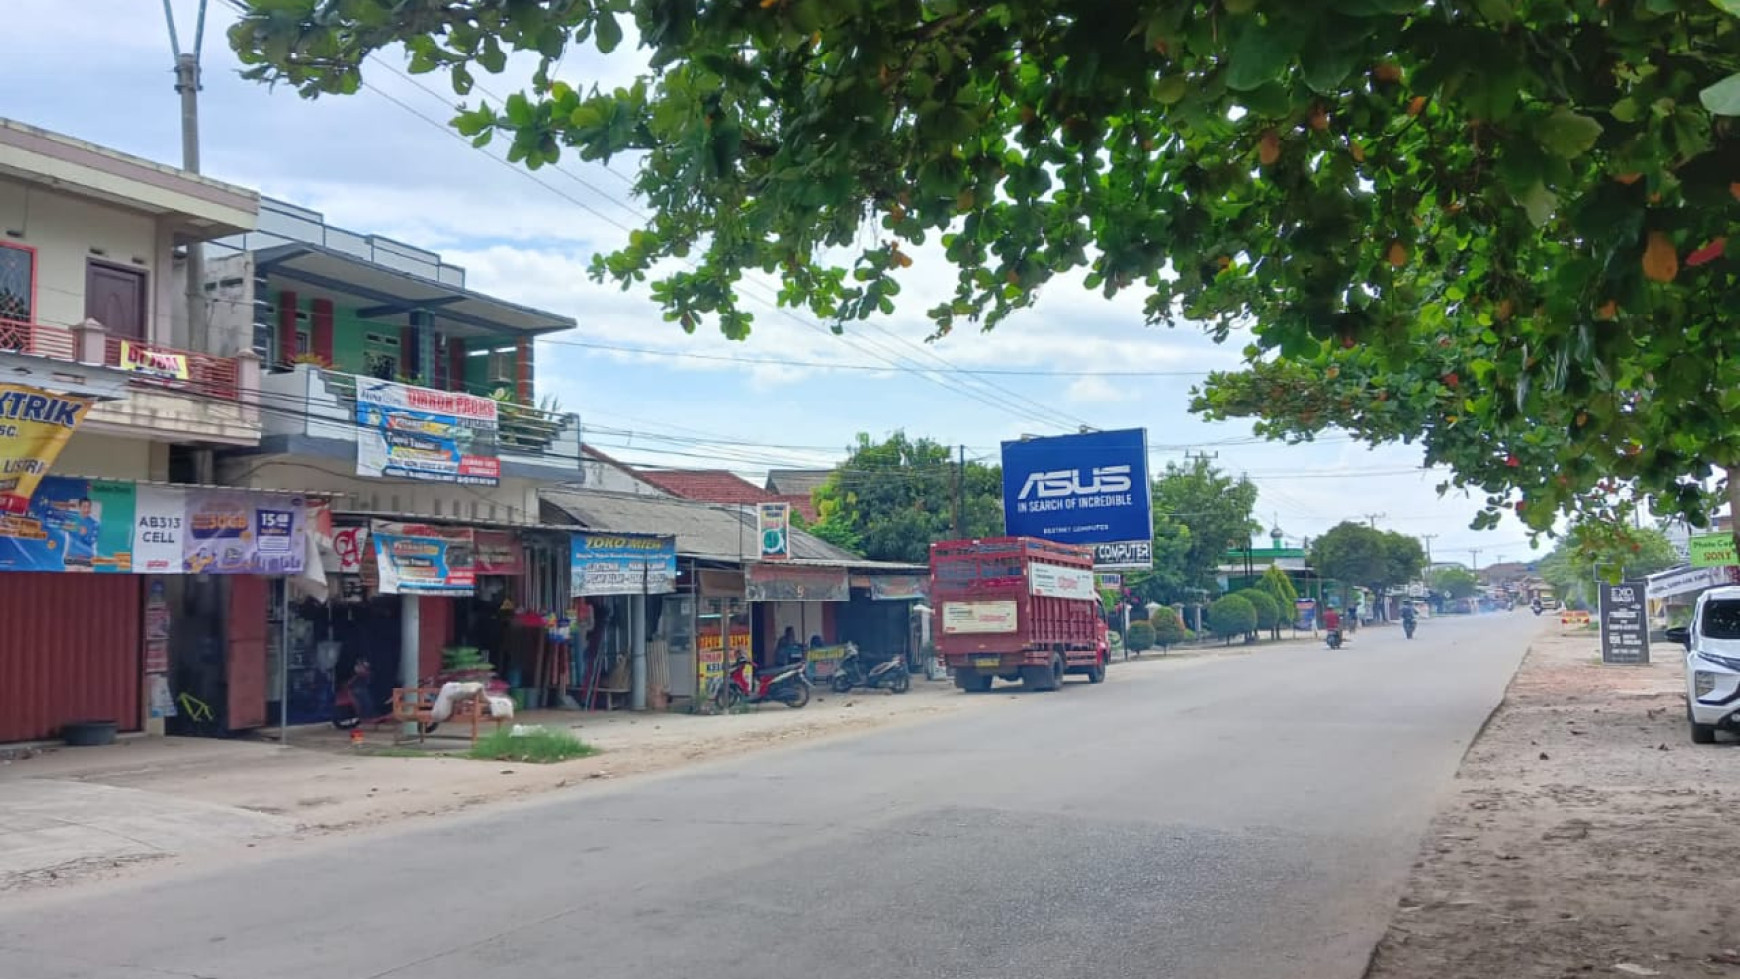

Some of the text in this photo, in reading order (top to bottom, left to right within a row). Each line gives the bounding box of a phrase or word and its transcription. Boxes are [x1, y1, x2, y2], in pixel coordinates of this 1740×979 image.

[1018, 465, 1132, 499] ASUS
[1018, 494, 1132, 513] IN SEARCH OF INCREDIBLE
[139, 516, 181, 529] AB313
[142, 531, 175, 543] CELL
[1099, 544, 1148, 560] COMPUTER
